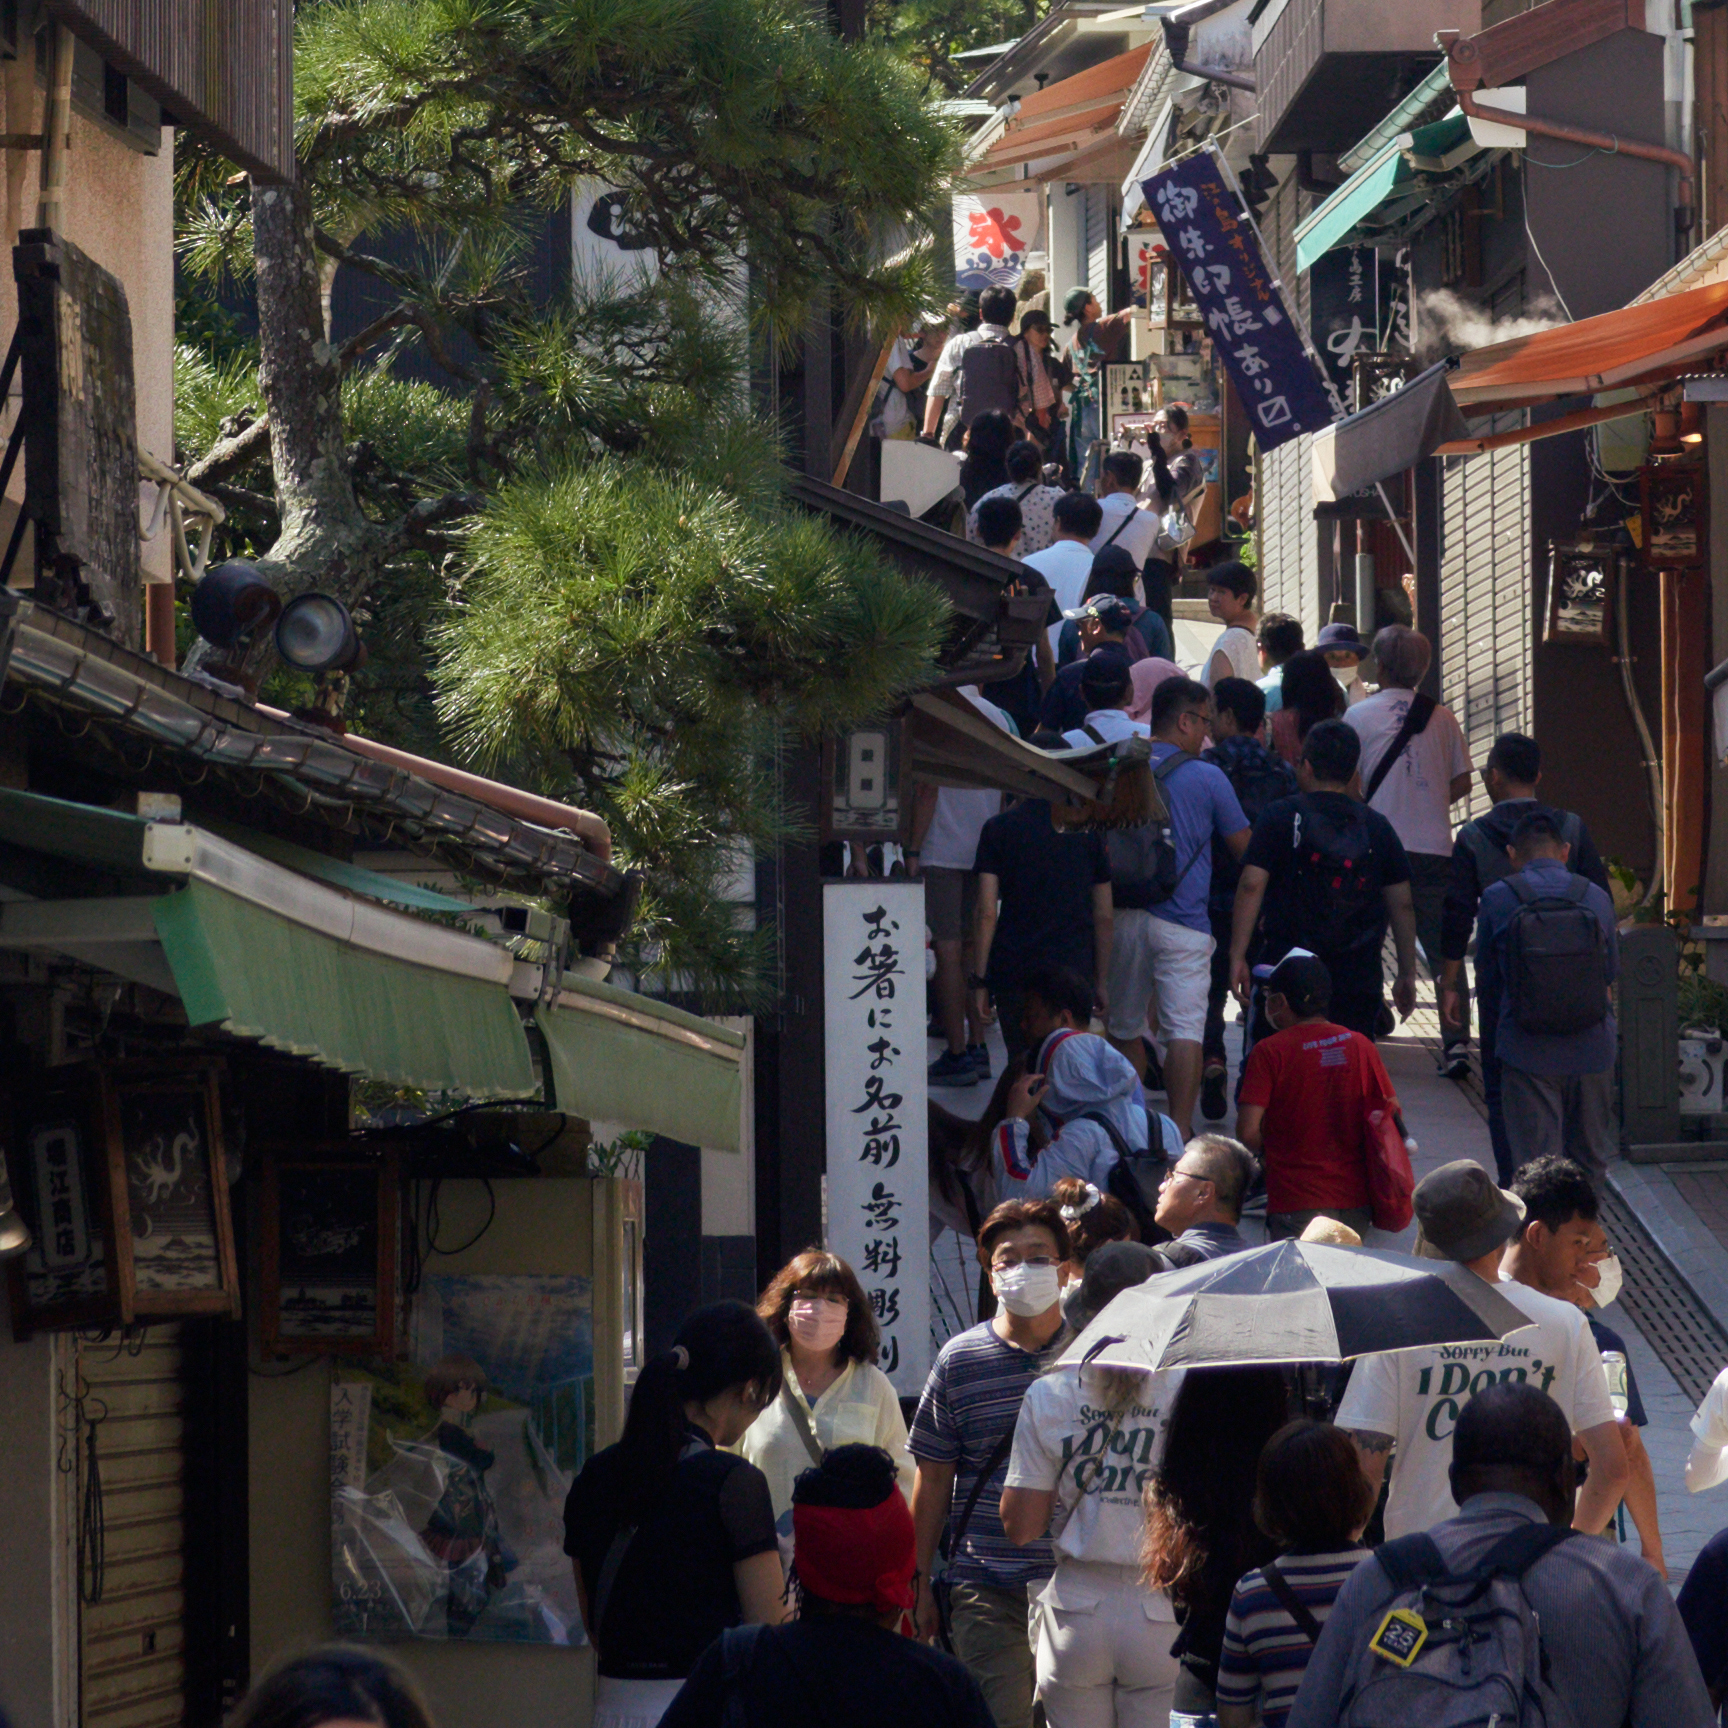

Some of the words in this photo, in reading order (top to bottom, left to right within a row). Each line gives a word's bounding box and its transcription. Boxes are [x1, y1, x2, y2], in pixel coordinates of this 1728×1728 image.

[968, 207, 1027, 259] 氷
[1498, 1344, 1530, 1357] But
[1417, 1366, 1433, 1395] I
[1081, 1419, 1169, 1464] Don'
[339, 1579, 382, 1601] 6.23
[1384, 1624, 1414, 1647] 25
